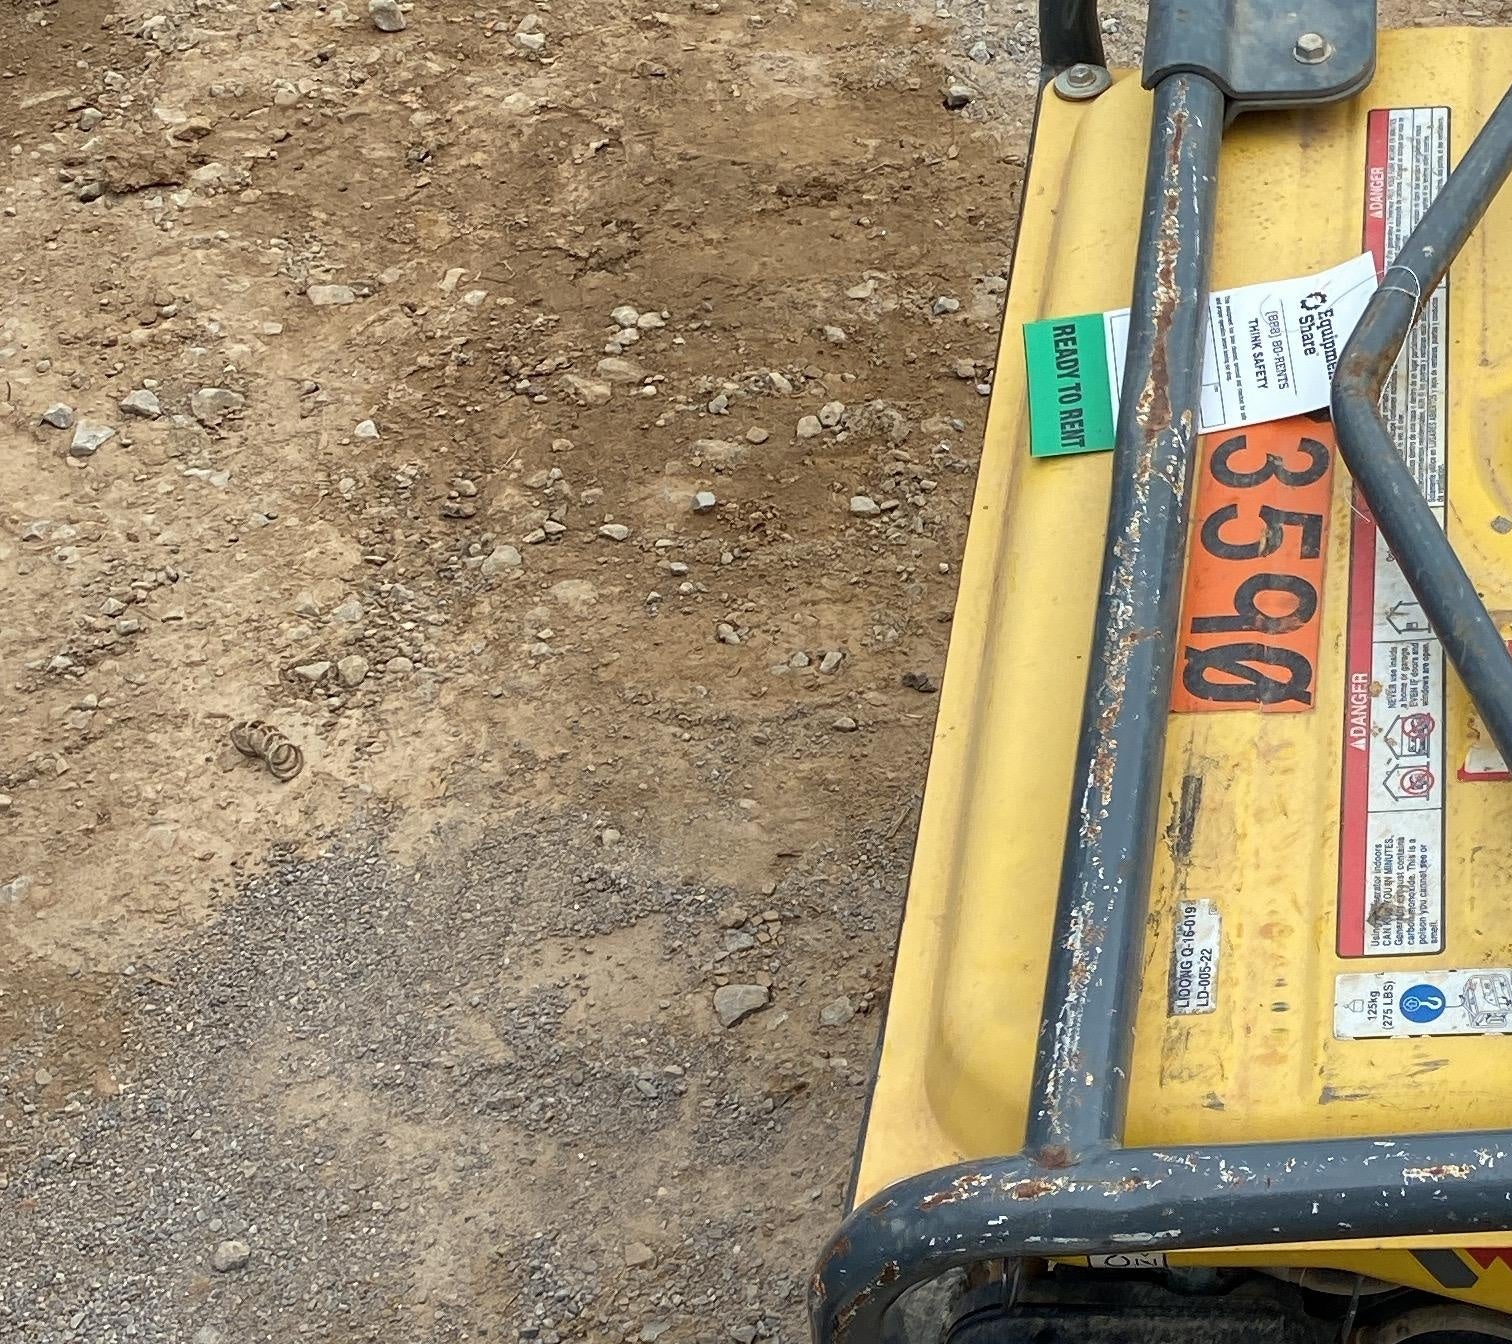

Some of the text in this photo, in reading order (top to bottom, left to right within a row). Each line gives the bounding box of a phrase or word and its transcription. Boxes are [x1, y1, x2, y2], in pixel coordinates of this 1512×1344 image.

[1368, 167, 1384, 210] DANGER
[1248, 318, 1268, 389] THINK SAFETY
[1299, 314, 1317, 356] Share
[1316, 308, 1339, 381] Equipme
[1052, 324, 1085, 448] READY TO RENT
[1183, 406, 1331, 706] 3590
[1350, 673, 1368, 737] DANGER
[1410, 687, 1418, 707] EVEN
[1372, 843, 1382, 874] indoors
[1395, 837, 1405, 870] contains
[1406, 855, 1416, 871] This
[1384, 887, 1392, 904] YOU
[1420, 870, 1428, 898] cannot
[1383, 928, 1392, 947] CAN
[1394, 905, 1405, 946] Generator
[1406, 917, 1416, 946] carbon
[1419, 917, 1429, 945] poison
[1177, 906, 1197, 1008] LIDONG Q-16-019
[1197, 949, 1212, 1007] LD-005-22
[1368, 991, 1381, 1021] 125kg
[1382, 980, 1396, 1030] (275 LBS)
